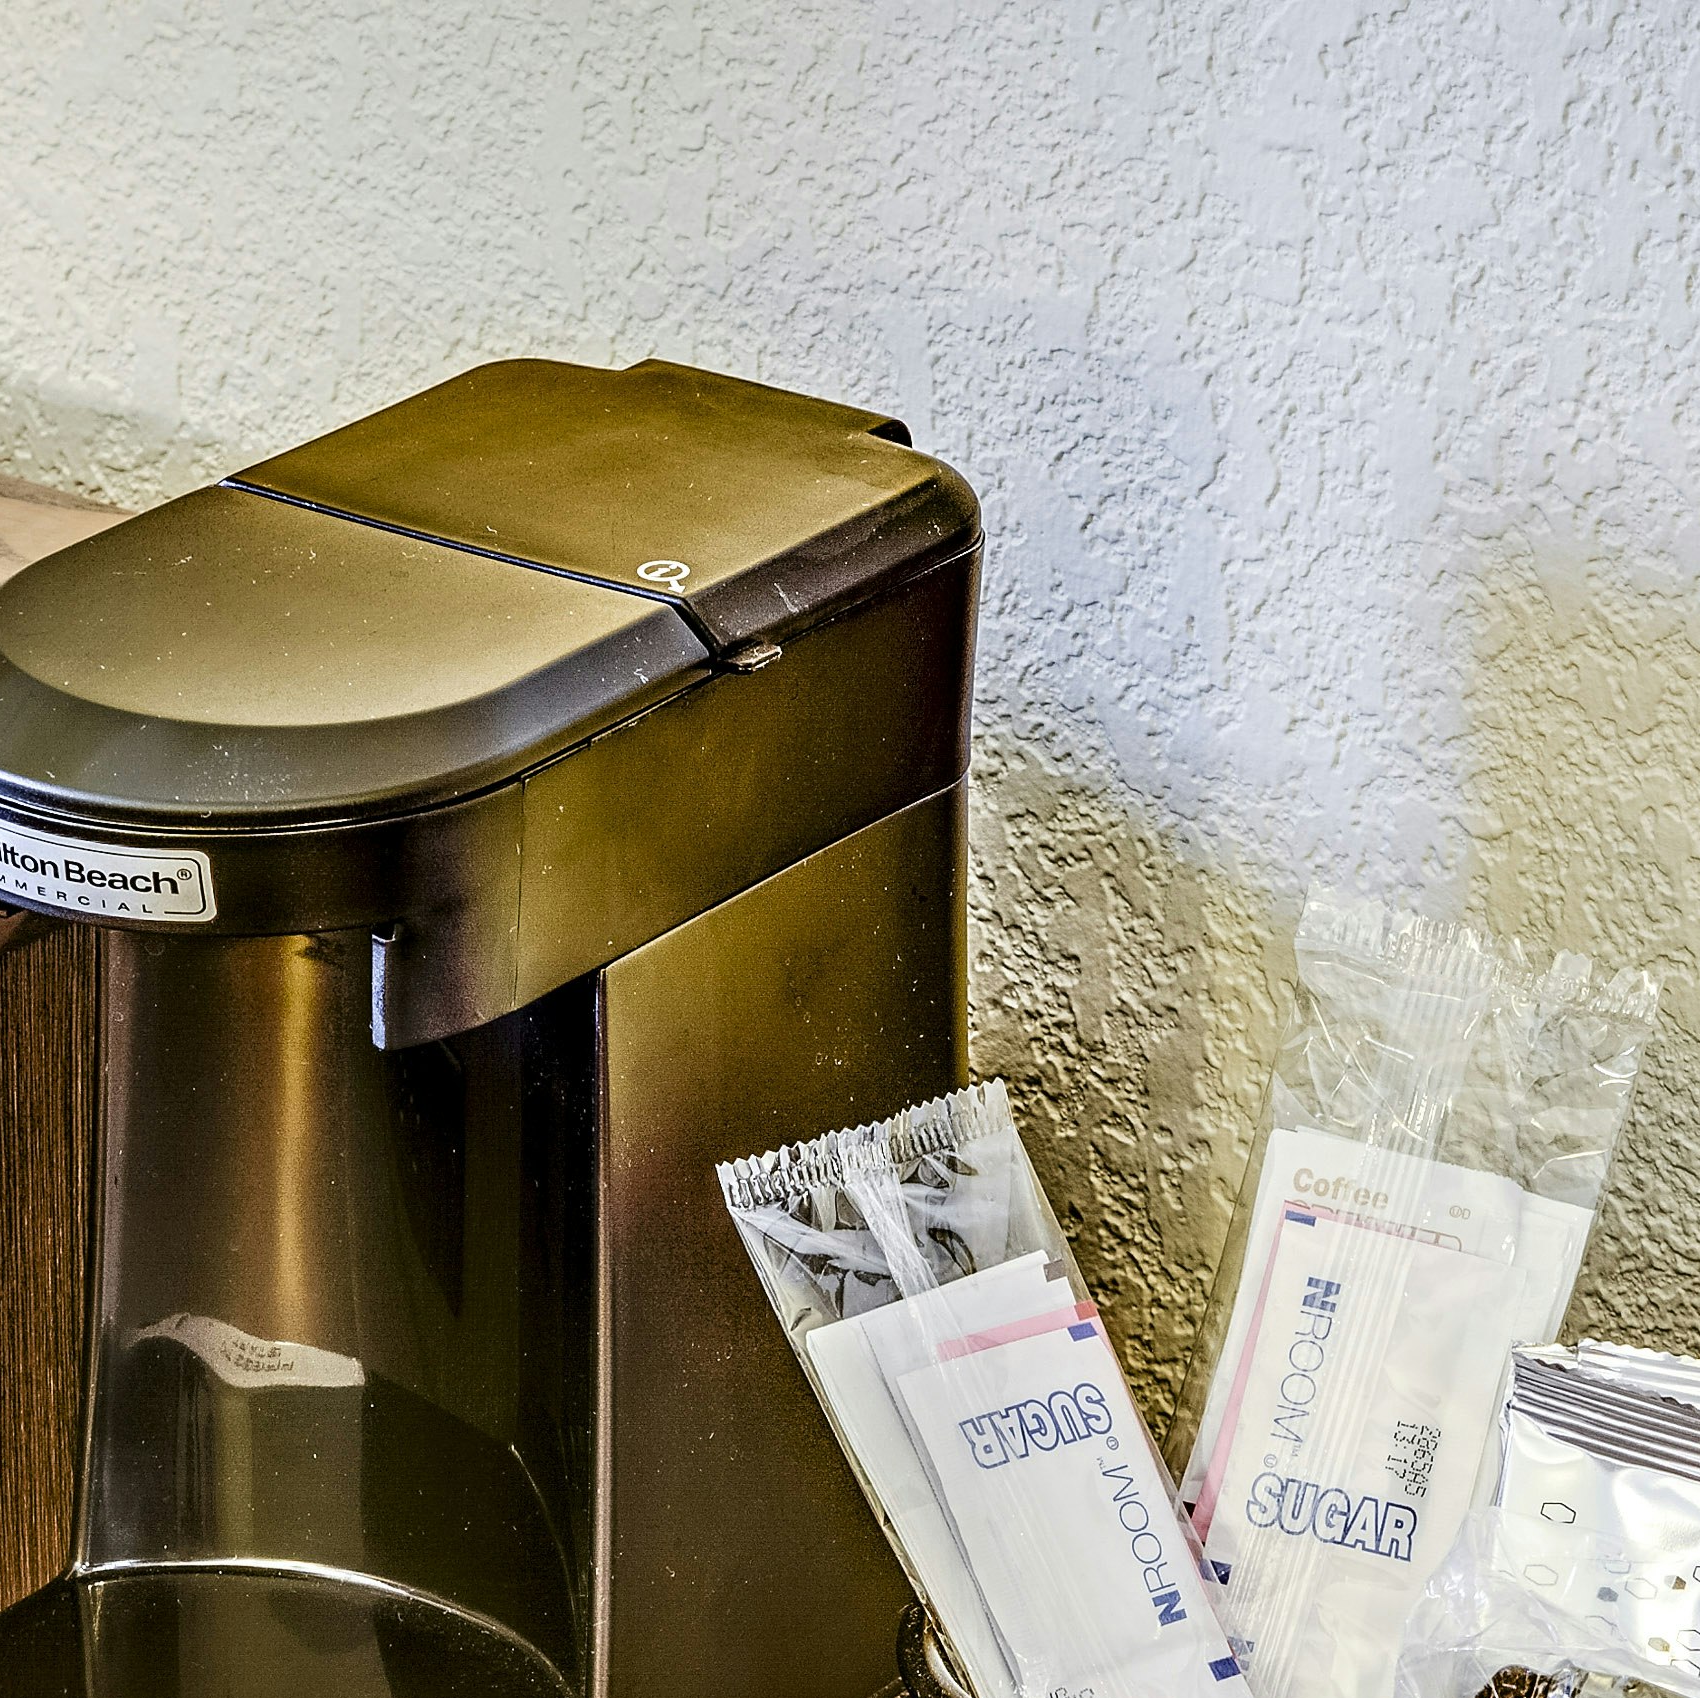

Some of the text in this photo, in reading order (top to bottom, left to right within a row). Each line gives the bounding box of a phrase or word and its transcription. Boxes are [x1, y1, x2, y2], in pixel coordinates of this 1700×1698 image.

[1293, 1167, 1389, 1210] Coffee
[958, 1382, 1113, 1471] SUGAR
[1245, 1471, 1418, 1562] SUGAR
